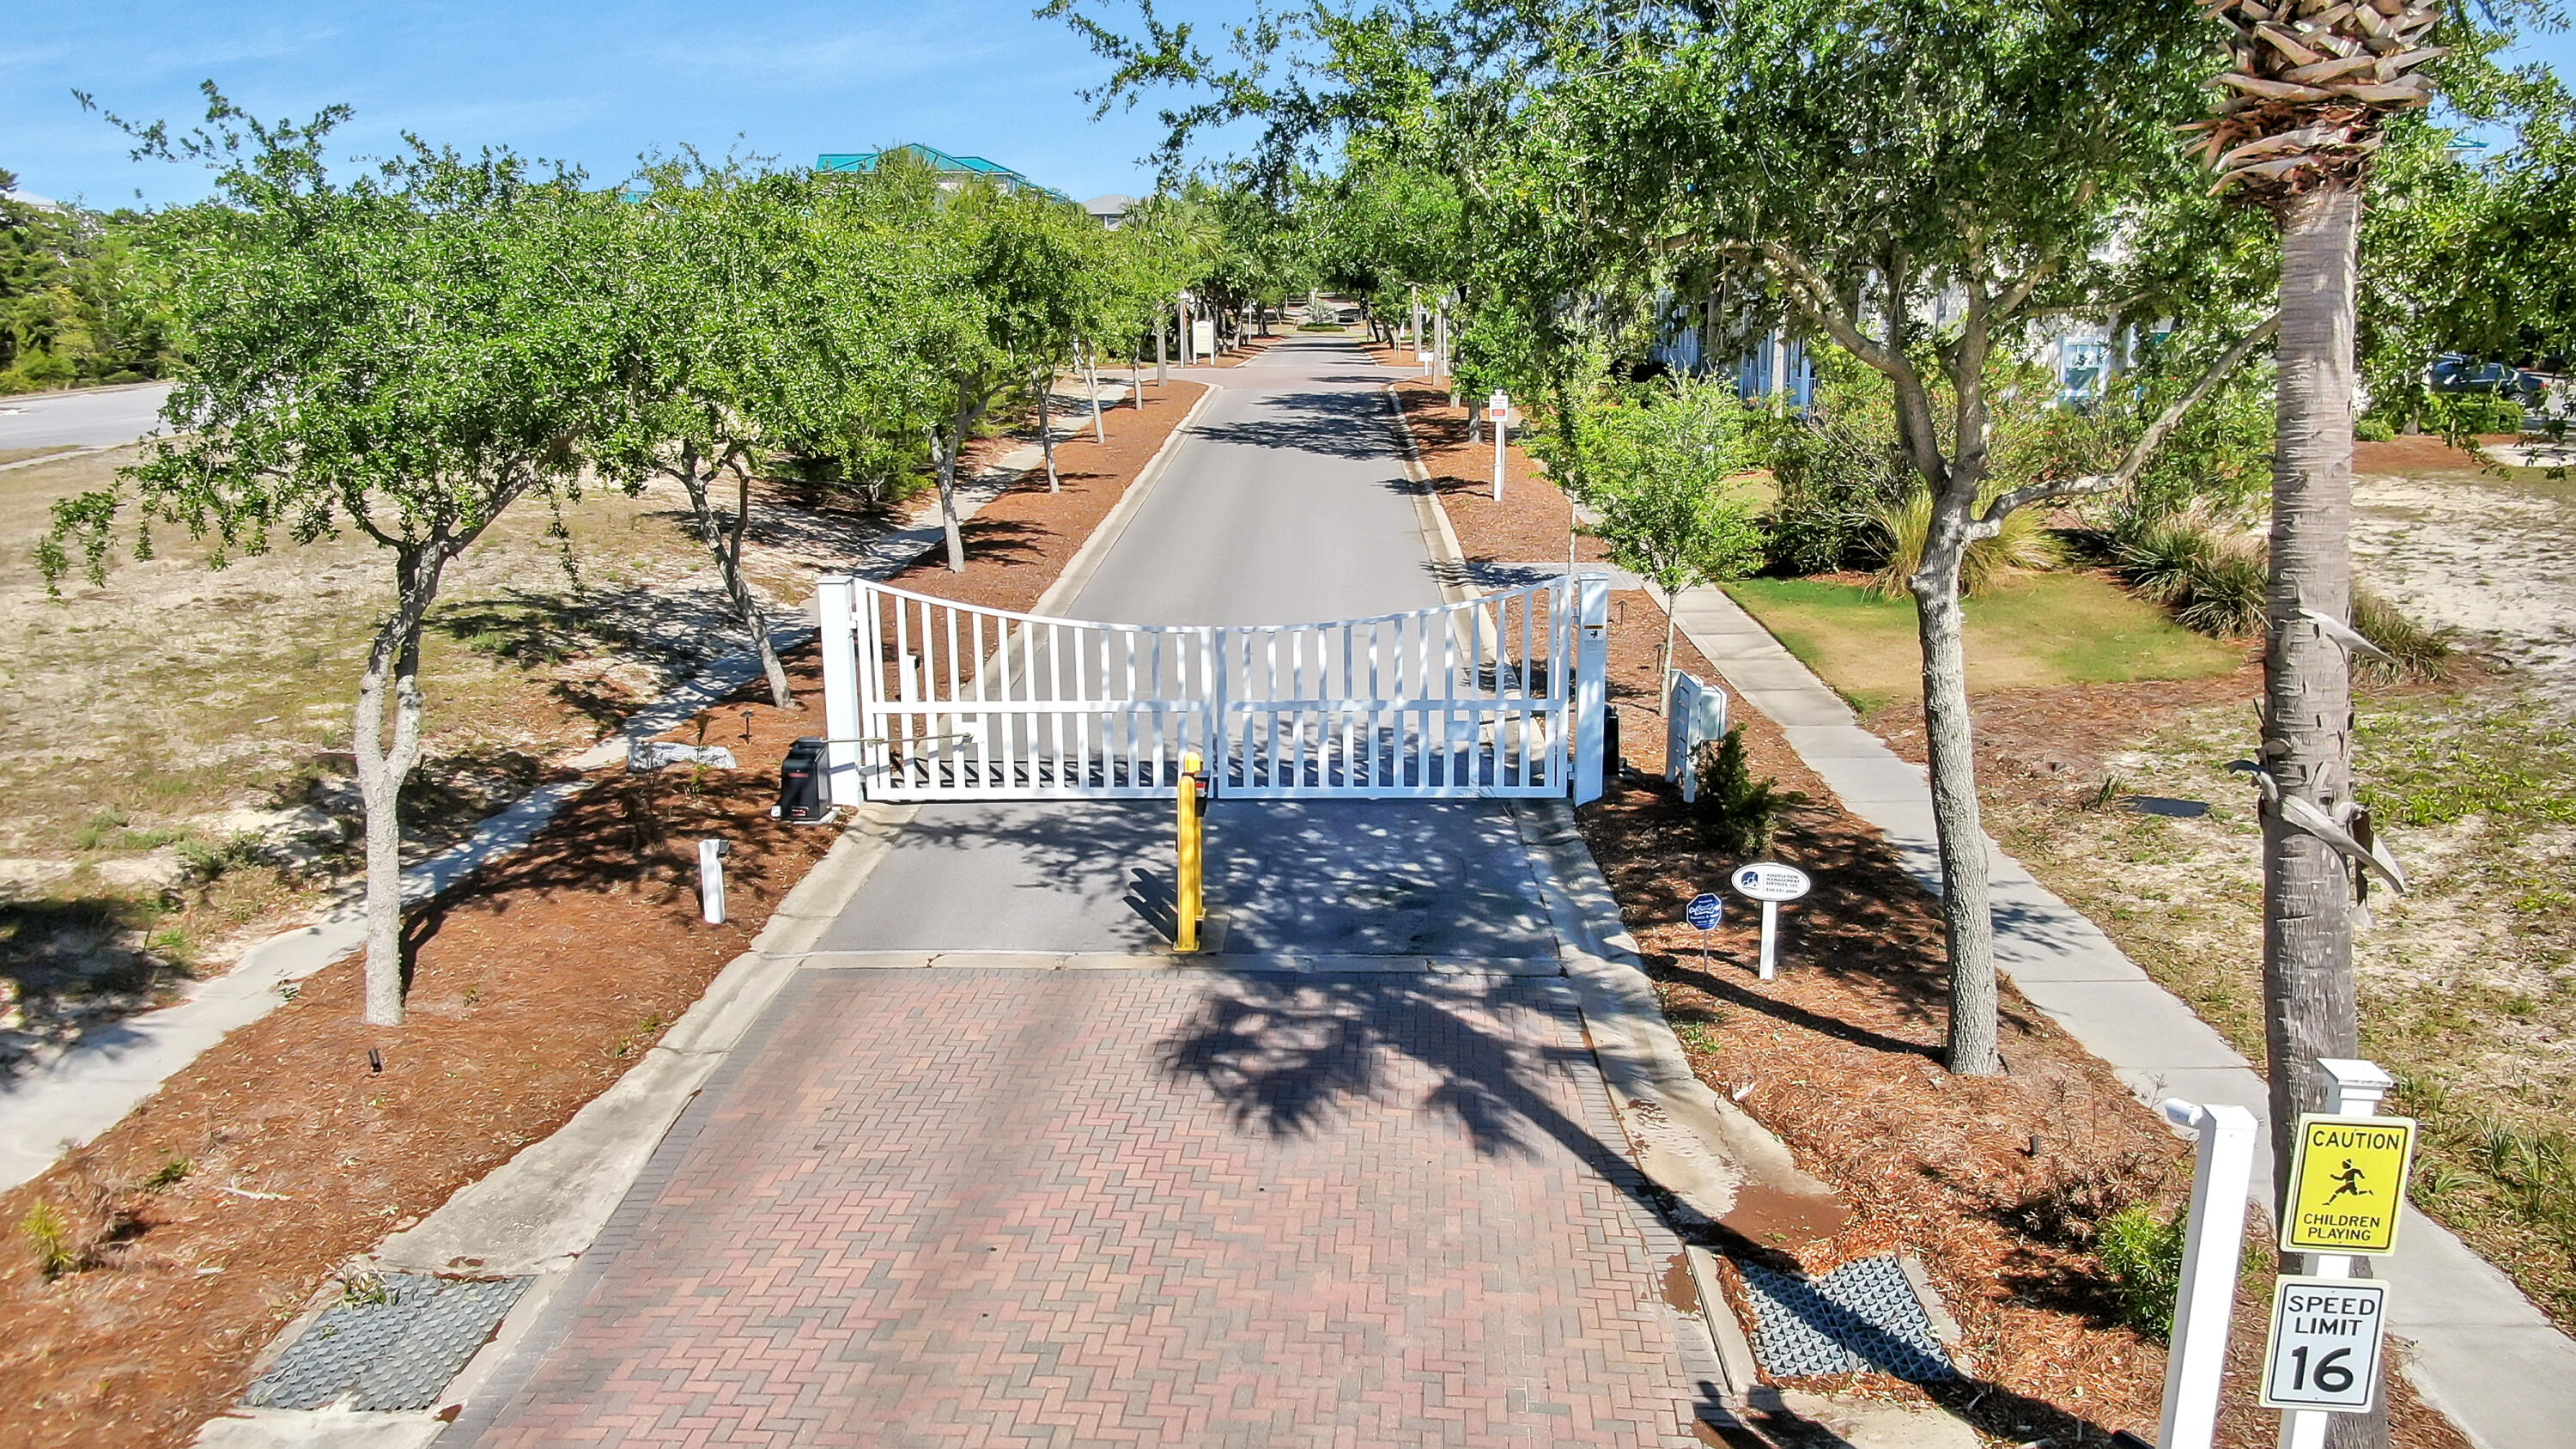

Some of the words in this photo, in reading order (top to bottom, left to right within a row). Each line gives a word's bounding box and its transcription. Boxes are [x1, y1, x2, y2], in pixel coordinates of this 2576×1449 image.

[2312, 1130, 2400, 1150] CAUTION
[2304, 1213, 2380, 1228] CHILDREN
[2307, 1227, 2371, 1241] PLAYING
[2287, 1295, 2376, 1316] SPEED
[2294, 1317, 2363, 1336] LIMIT
[2292, 1346, 2354, 1393] 16
